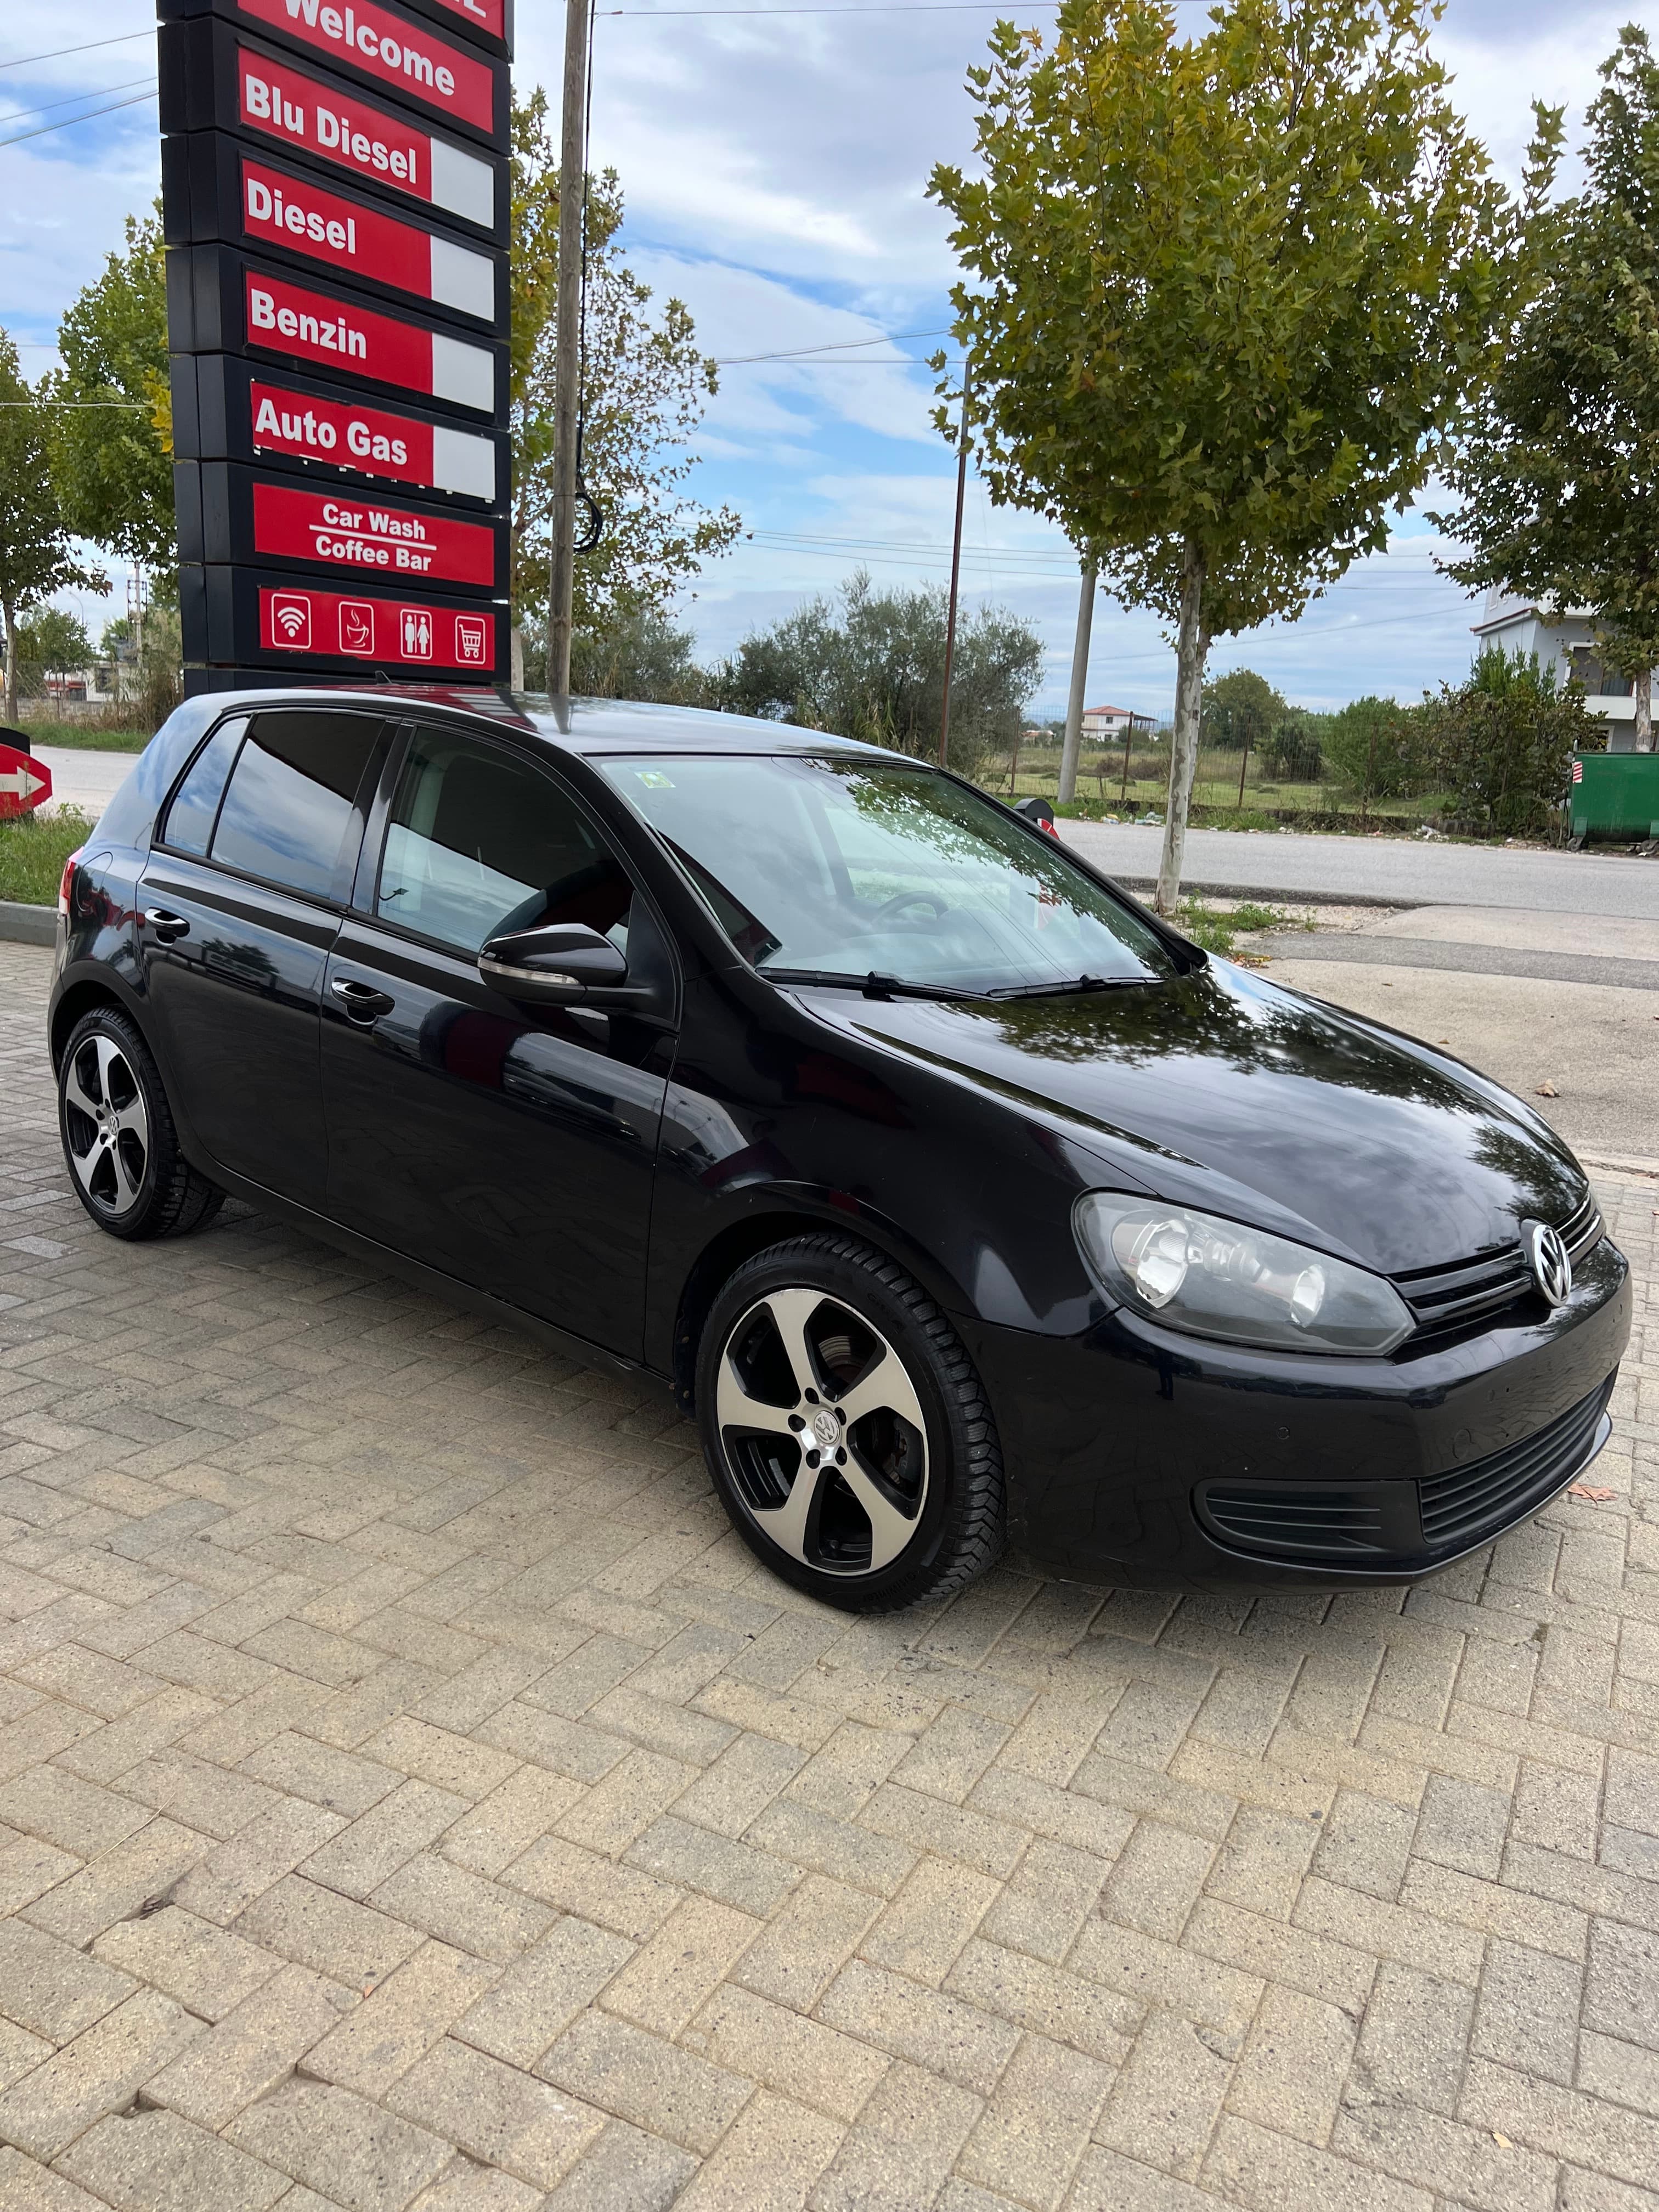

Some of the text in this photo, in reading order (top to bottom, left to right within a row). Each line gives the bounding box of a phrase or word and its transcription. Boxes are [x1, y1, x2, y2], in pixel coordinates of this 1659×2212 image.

[285, 0, 455, 96] Welcome
[245, 74, 416, 184] Blu Diesel
[247, 178, 356, 255] Diesel
[251, 289, 366, 359] Benzin
[255, 398, 408, 465] Auto Gas
[316, 535, 432, 572] Coffee Bar
[323, 504, 426, 540] Car Wash
